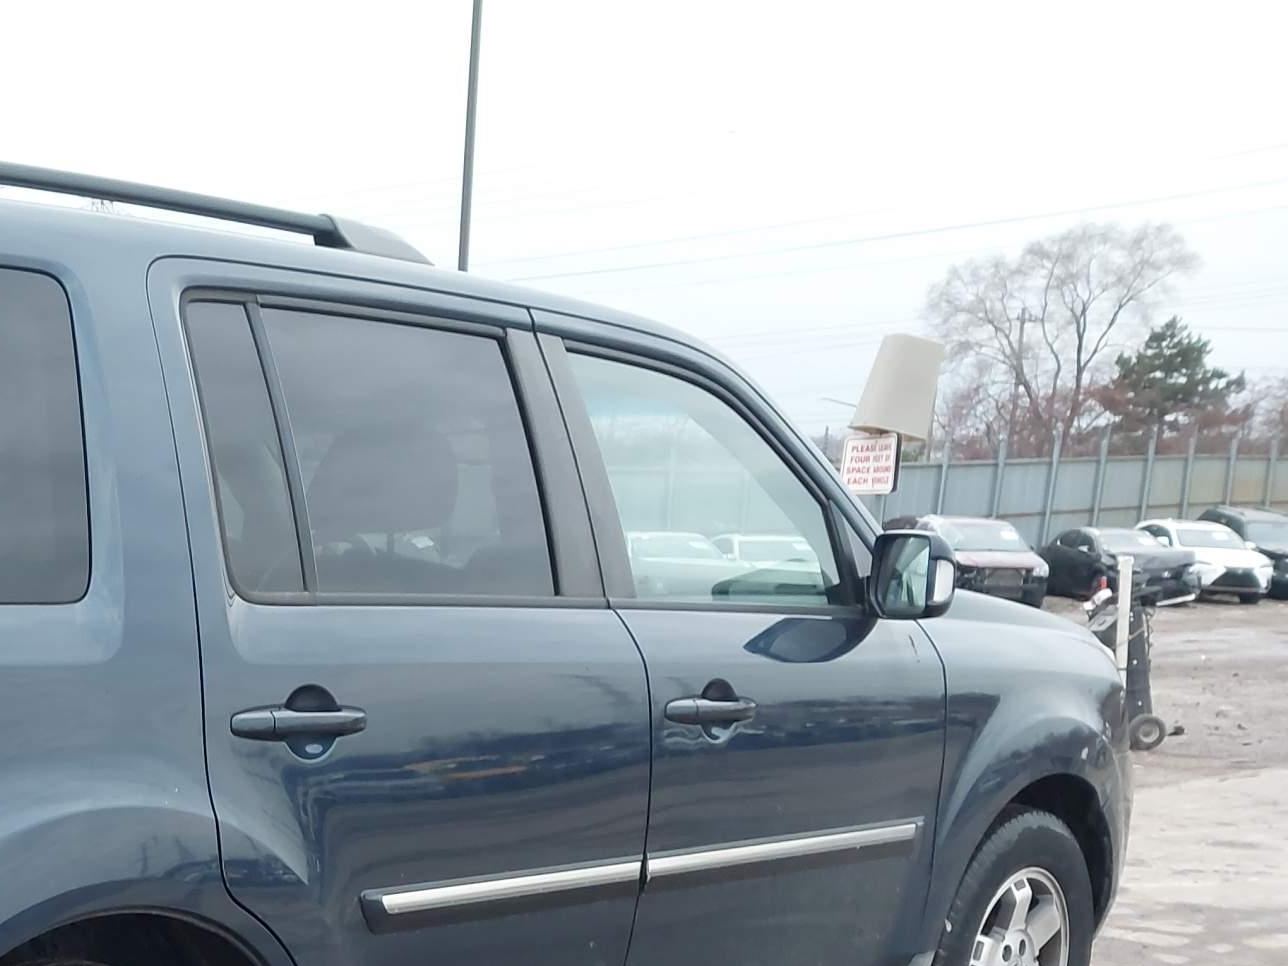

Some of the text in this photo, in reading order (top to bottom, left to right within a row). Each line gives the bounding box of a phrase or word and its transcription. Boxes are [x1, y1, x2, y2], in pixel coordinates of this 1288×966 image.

[851, 444, 877, 453] PLEASE
[850, 455, 871, 464] FOUR
[846, 466, 871, 475] SPACE
[847, 477, 869, 486] EACH
